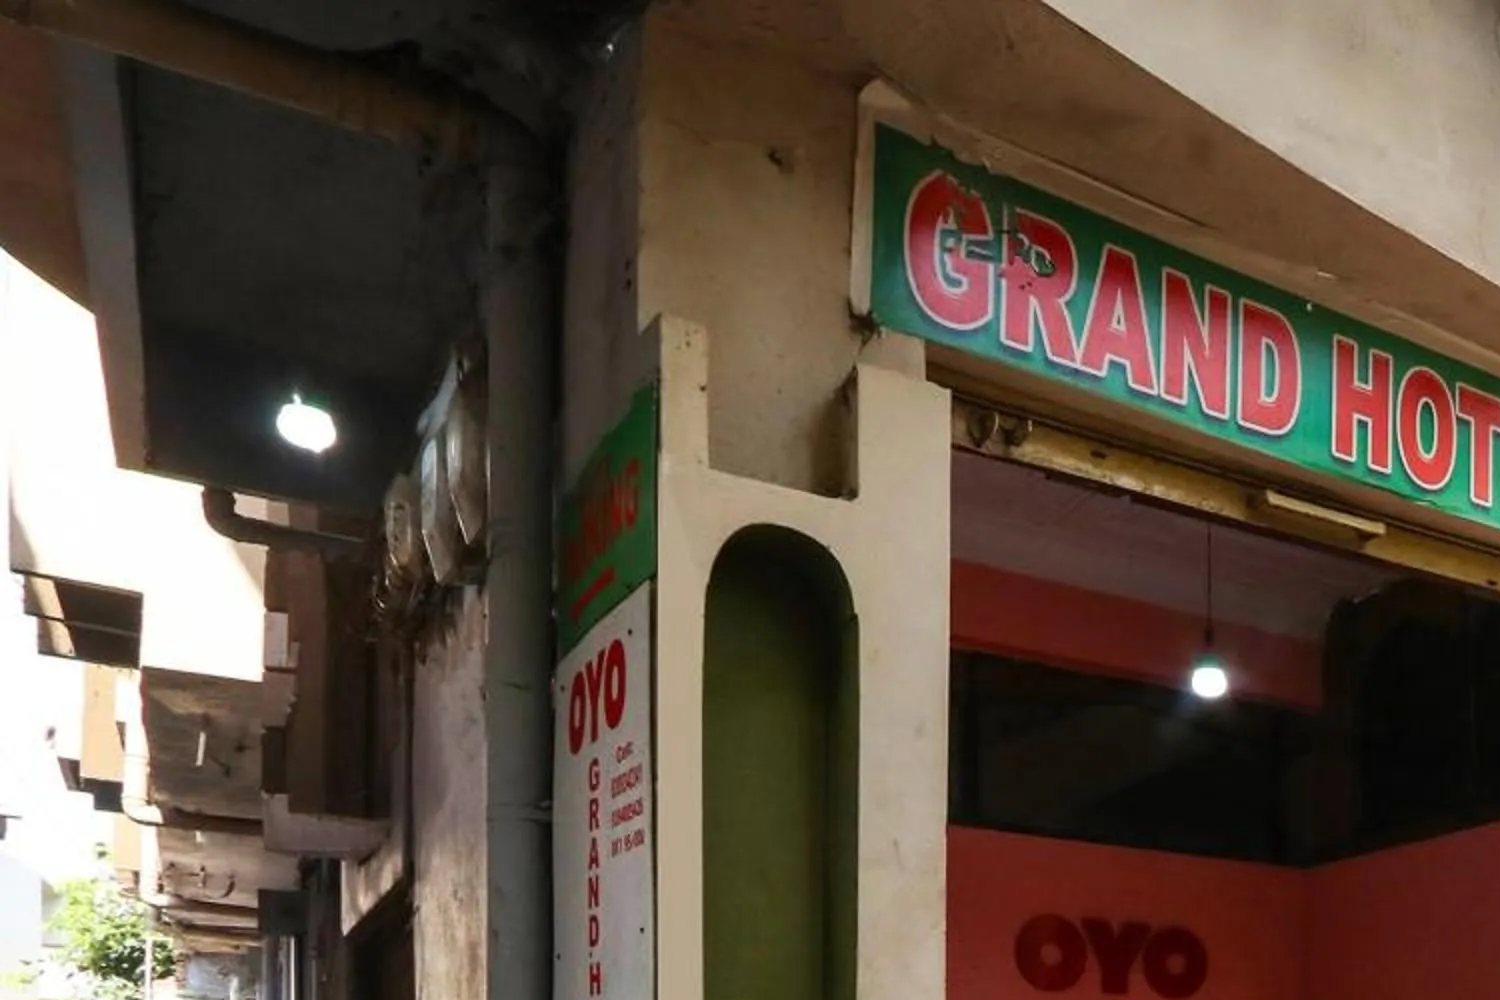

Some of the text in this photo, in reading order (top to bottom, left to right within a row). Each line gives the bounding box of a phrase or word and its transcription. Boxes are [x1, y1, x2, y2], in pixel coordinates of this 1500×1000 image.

[904, 168, 1301, 436] GRAND
[568, 638, 626, 755] OYO
[588, 757, 601, 948] GRAND
[1013, 913, 1209, 1000] OYO
